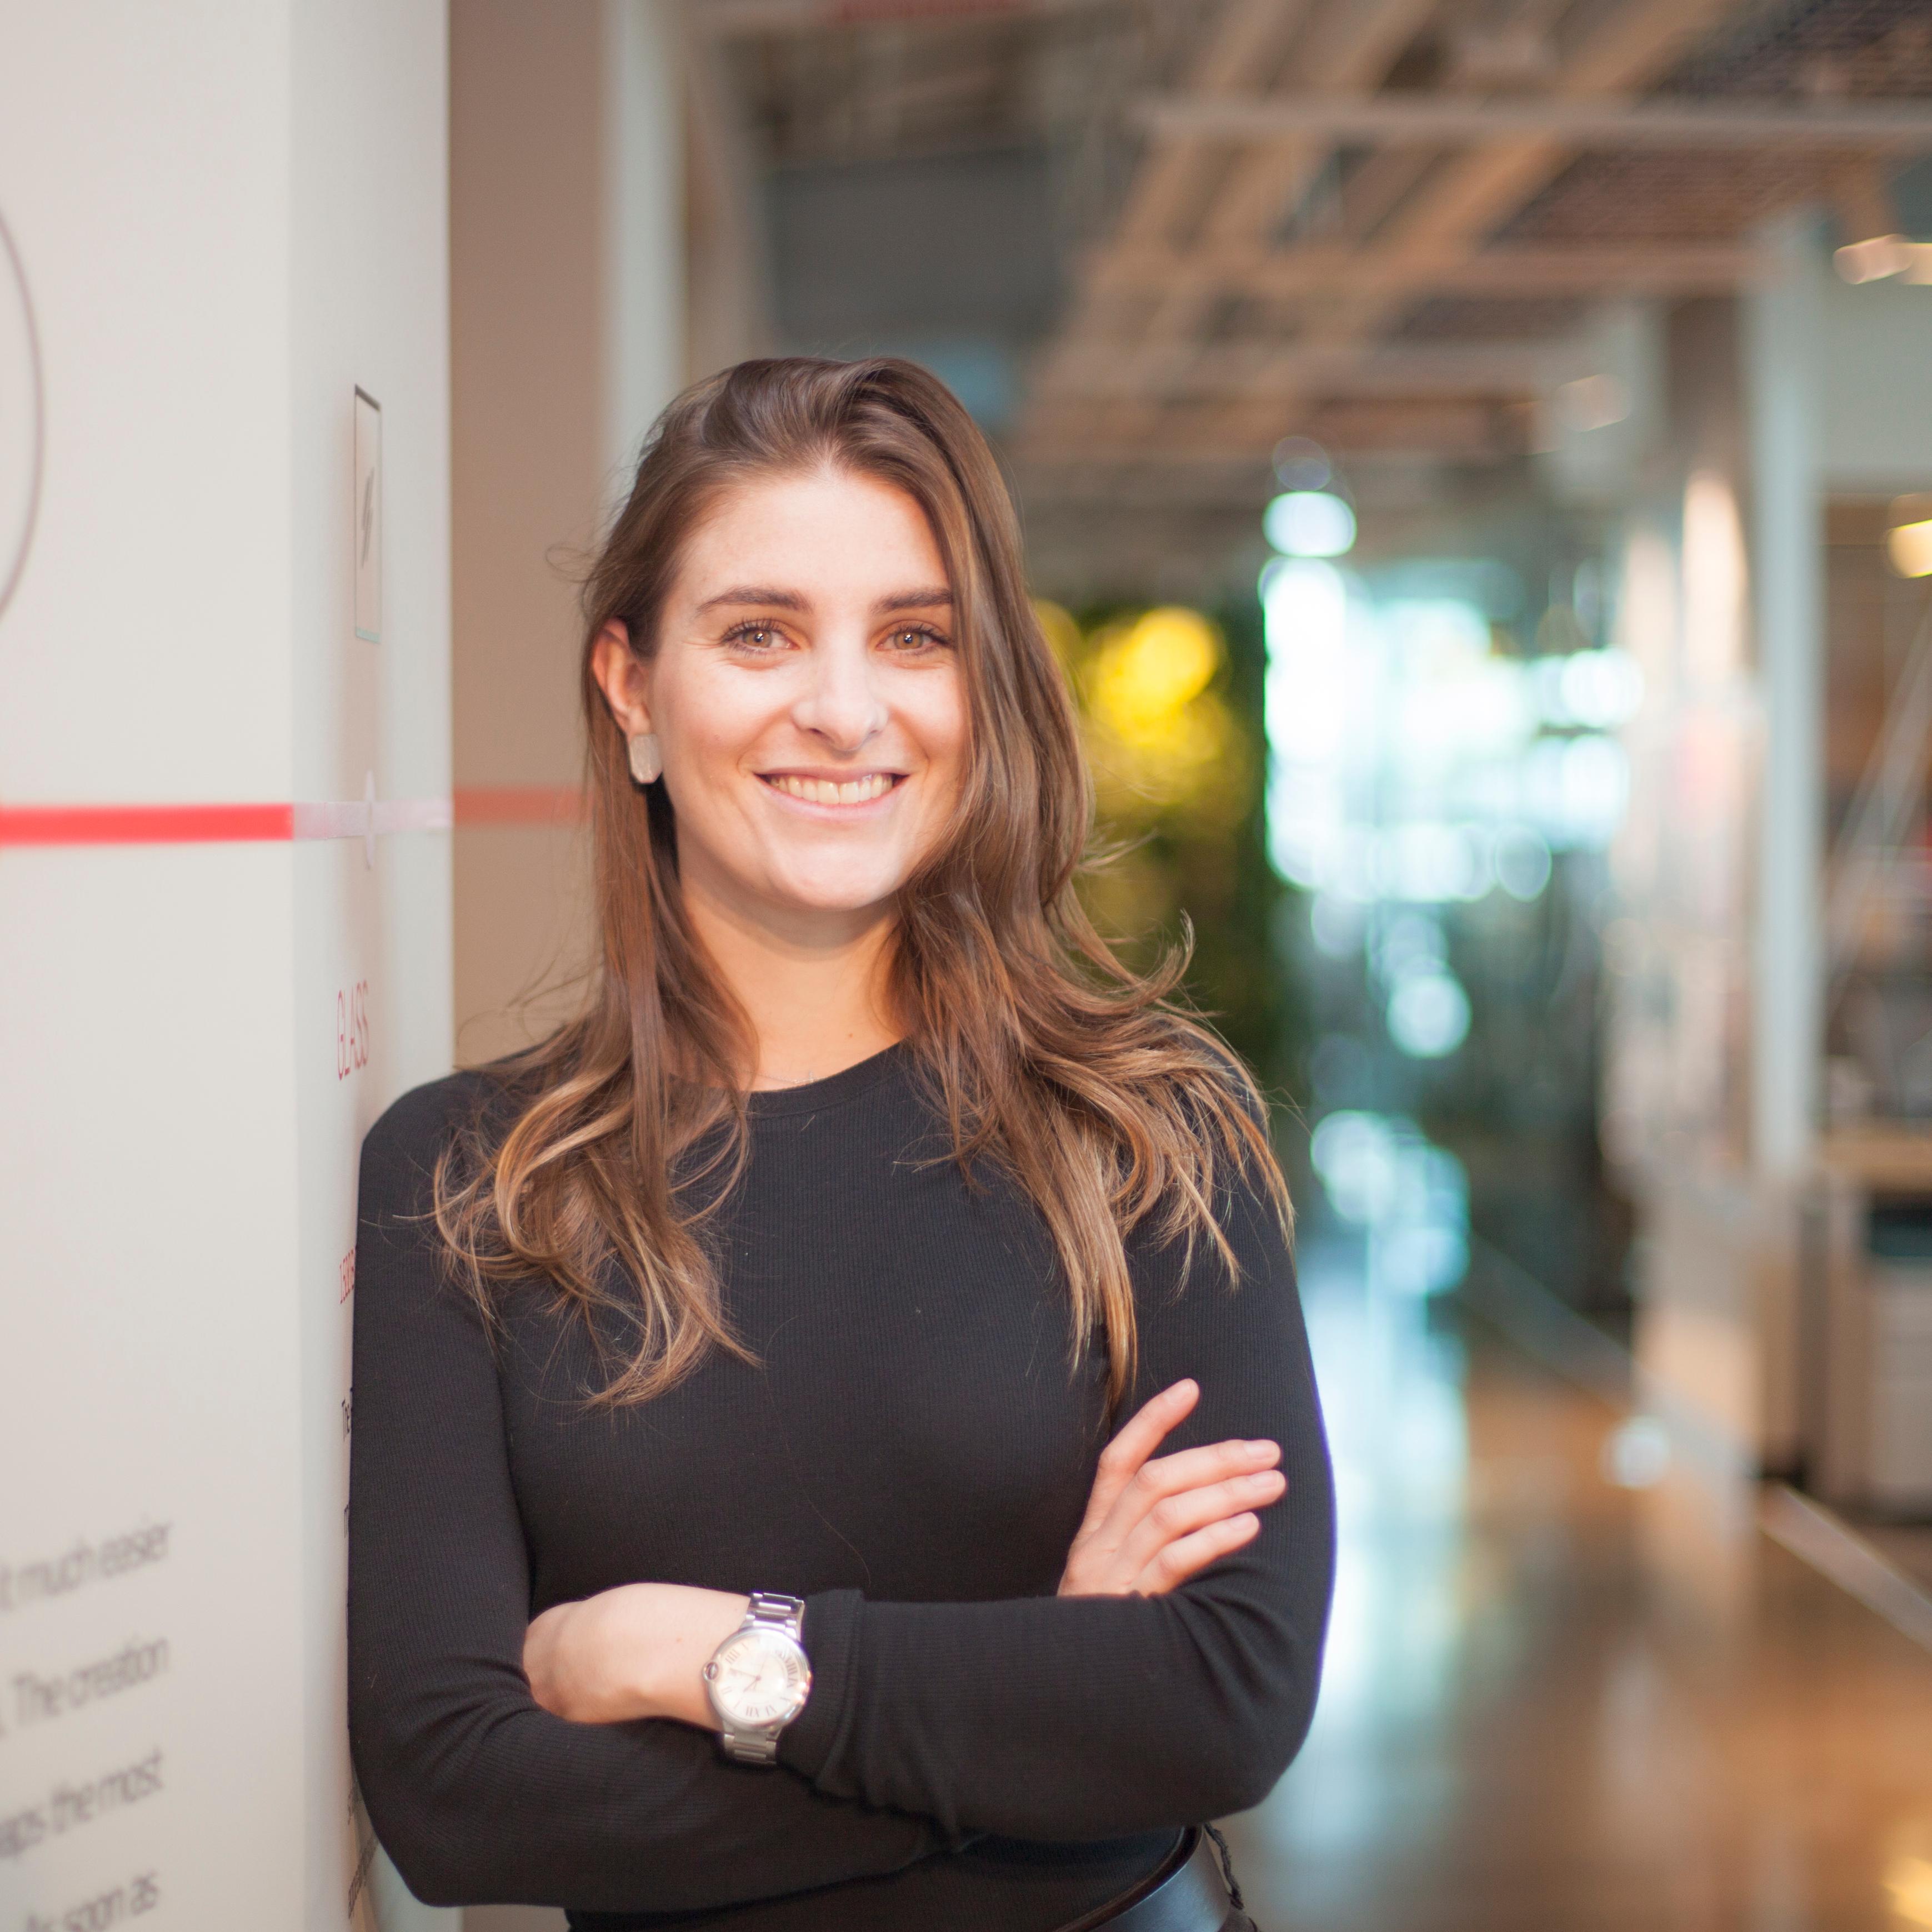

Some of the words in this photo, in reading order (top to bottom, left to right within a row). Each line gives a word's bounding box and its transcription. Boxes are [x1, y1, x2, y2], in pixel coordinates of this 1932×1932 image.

[337, 979, 369, 1081] GLASS
[16, 1533, 97, 1604] much
[99, 1513, 174, 1579] easier
[12, 1670, 63, 1725] The
[68, 1632, 169, 1709] creation
[52, 1779, 95, 1834] the
[98, 1745, 164, 1814] most
[131, 1868, 161, 1916] as
